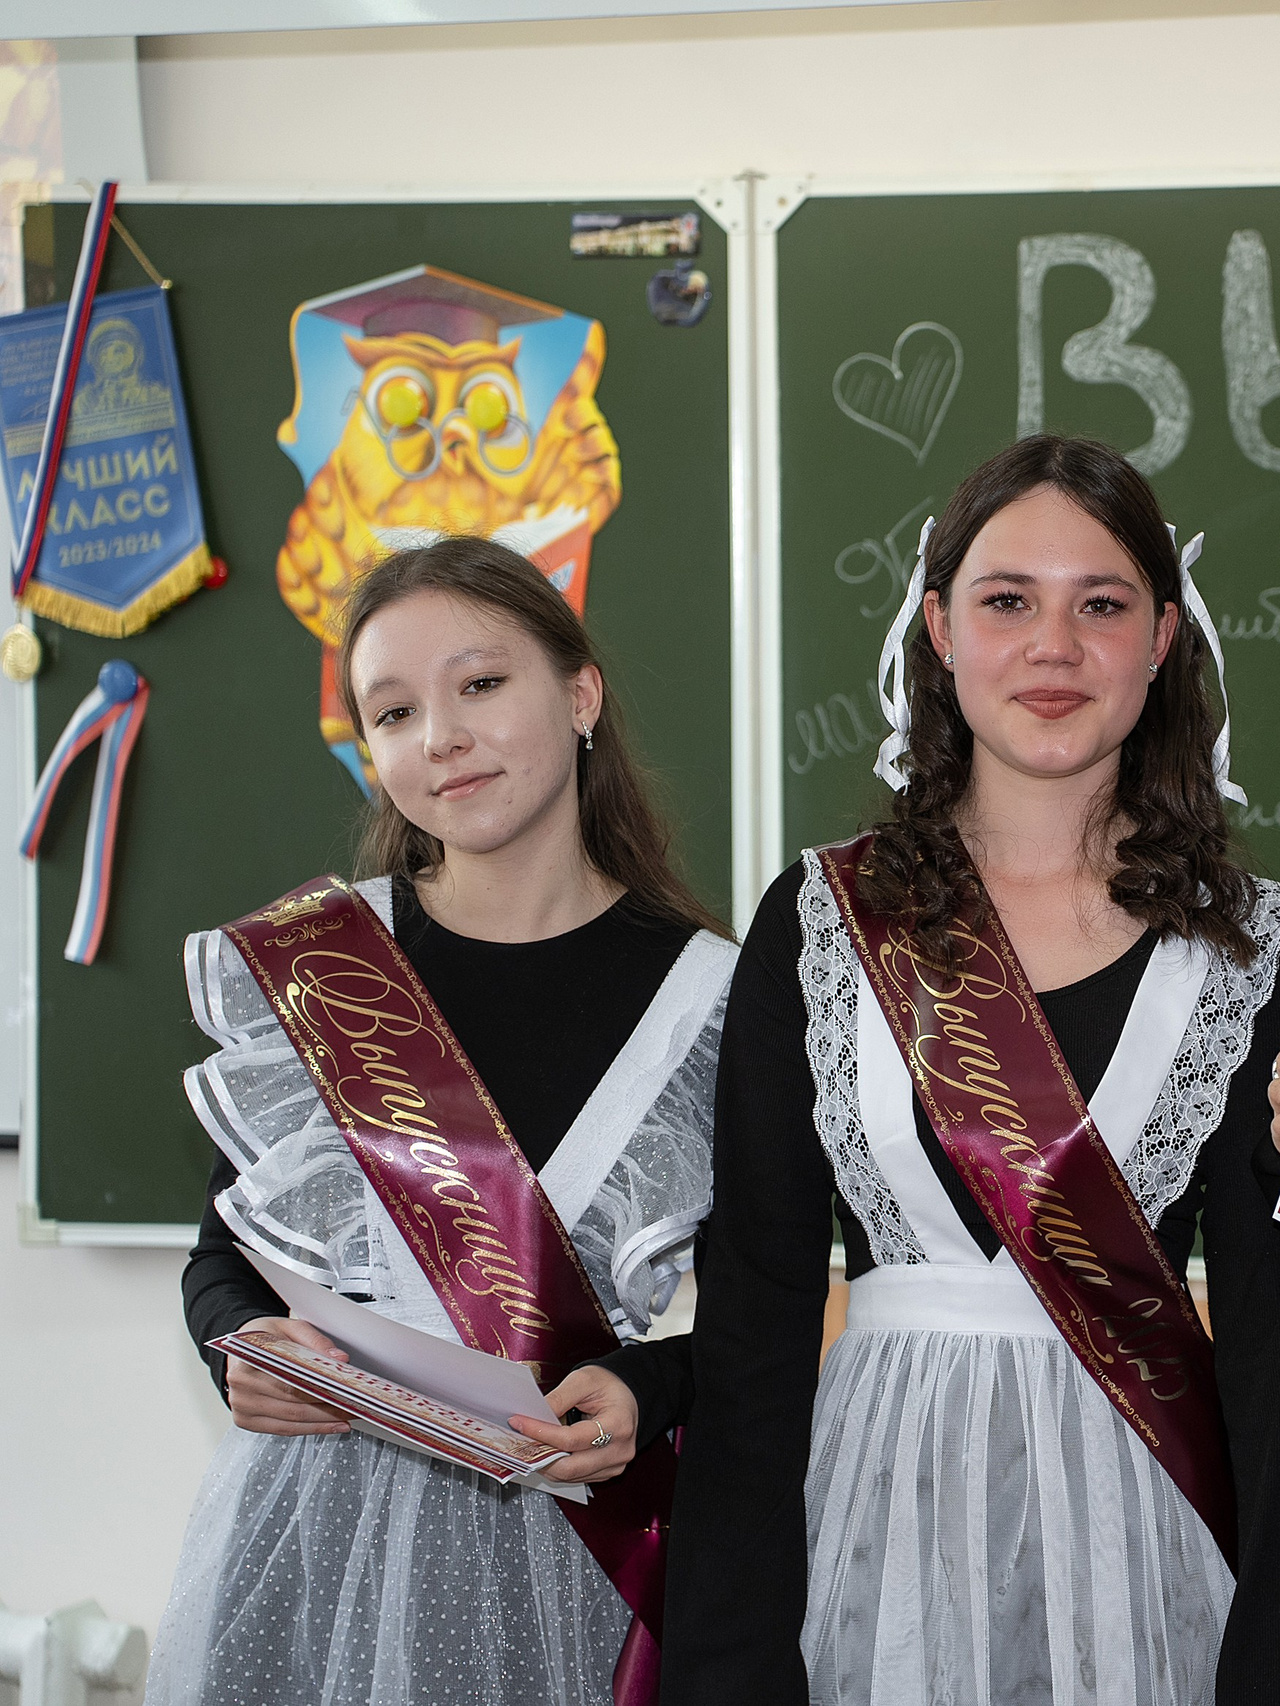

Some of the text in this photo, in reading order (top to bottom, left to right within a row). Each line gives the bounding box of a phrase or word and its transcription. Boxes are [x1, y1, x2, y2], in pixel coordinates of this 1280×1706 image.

[17, 434, 179, 503] ЛЧШИЙ
[58, 529, 162, 568] 2023/2024
[290, 950, 554, 1339] Выпускница
[887, 907, 1112, 1288] Выпускница
